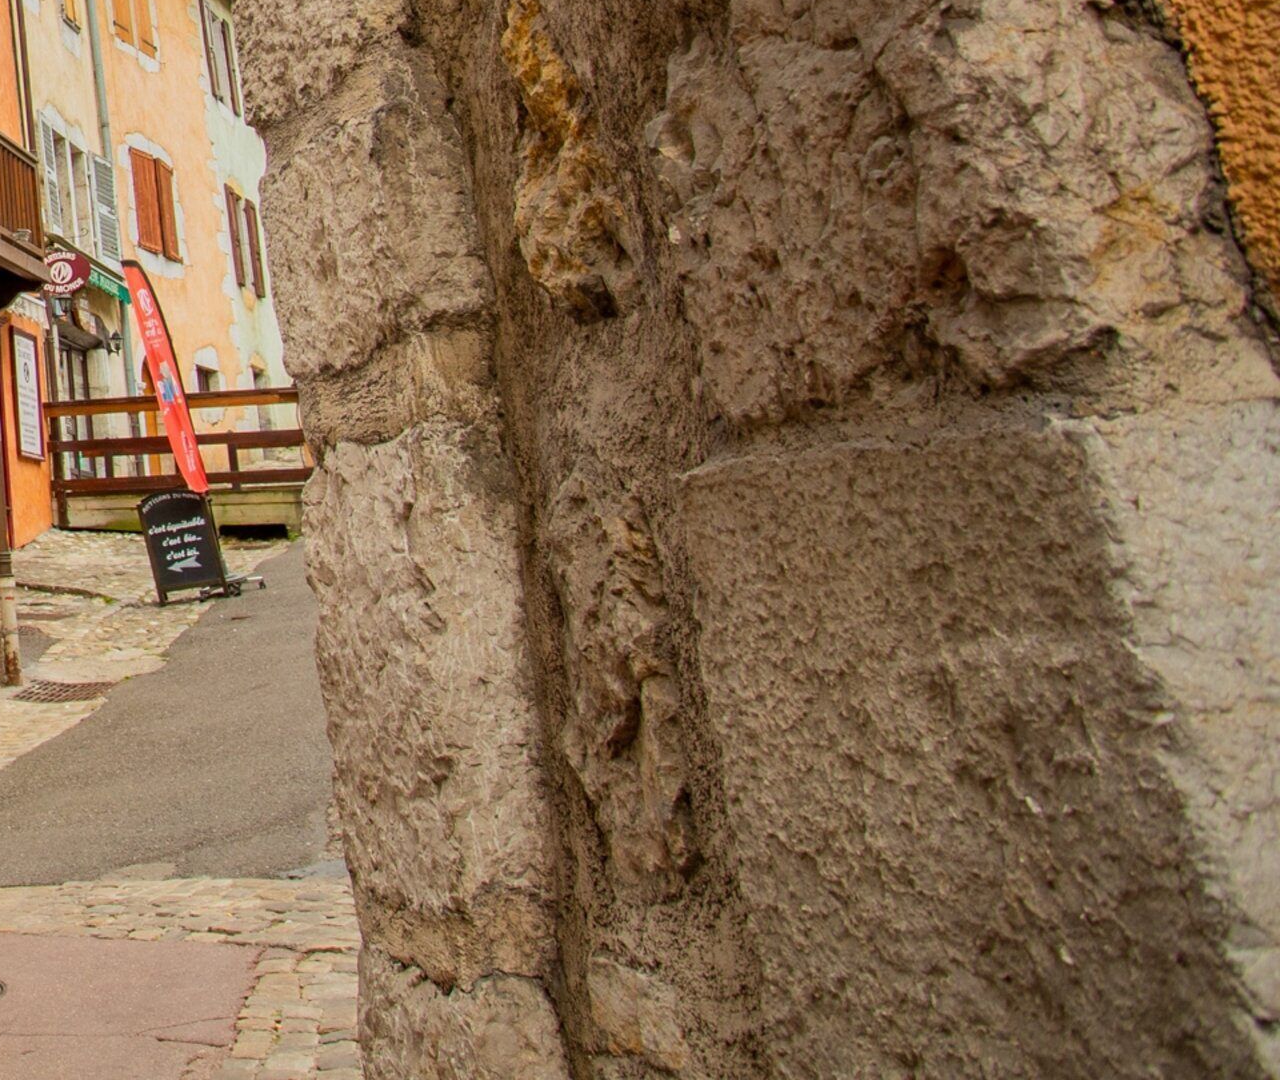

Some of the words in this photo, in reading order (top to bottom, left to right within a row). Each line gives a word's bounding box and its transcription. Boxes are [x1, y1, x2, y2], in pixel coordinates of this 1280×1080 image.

[44, 252, 76, 265] ARTISANS
[43, 283, 54, 292] DU
[55, 277, 84, 293] MONDE
[148, 525, 166, 535] c'est
[162, 536, 182, 547] c'est
[166, 550, 186, 560] c'est
